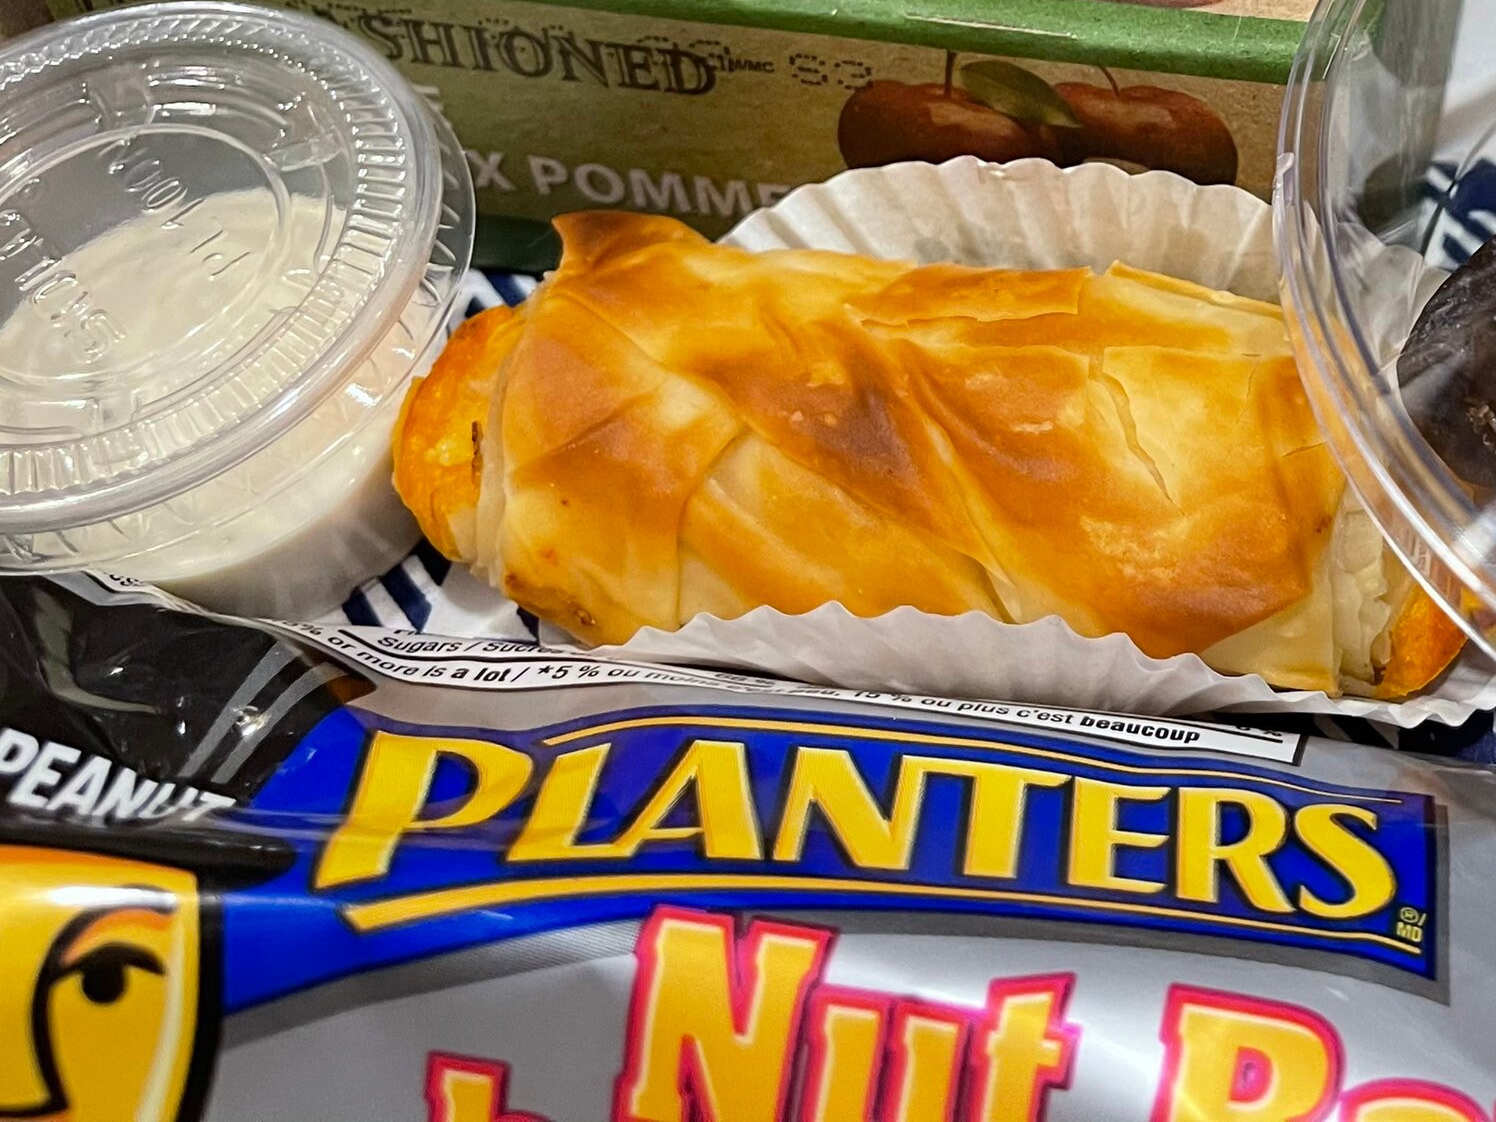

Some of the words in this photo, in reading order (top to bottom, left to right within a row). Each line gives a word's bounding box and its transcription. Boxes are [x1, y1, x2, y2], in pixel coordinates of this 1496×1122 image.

[328, 636, 358, 654] or
[366, 650, 419, 677] more
[423, 664, 446, 678] is
[451, 668, 469, 679] a
[474, 666, 511, 683] lot
[920, 697, 952, 709] ou
[957, 700, 1010, 717] plus
[1016, 708, 1076, 725] c'est
[1079, 715, 1201, 745] beaucoup
[377, 635, 463, 654] Sugars
[0, 727, 236, 821] PEANUT
[314, 731, 1397, 920] PLANTERS
[612, 903, 1080, 1122] Nut
